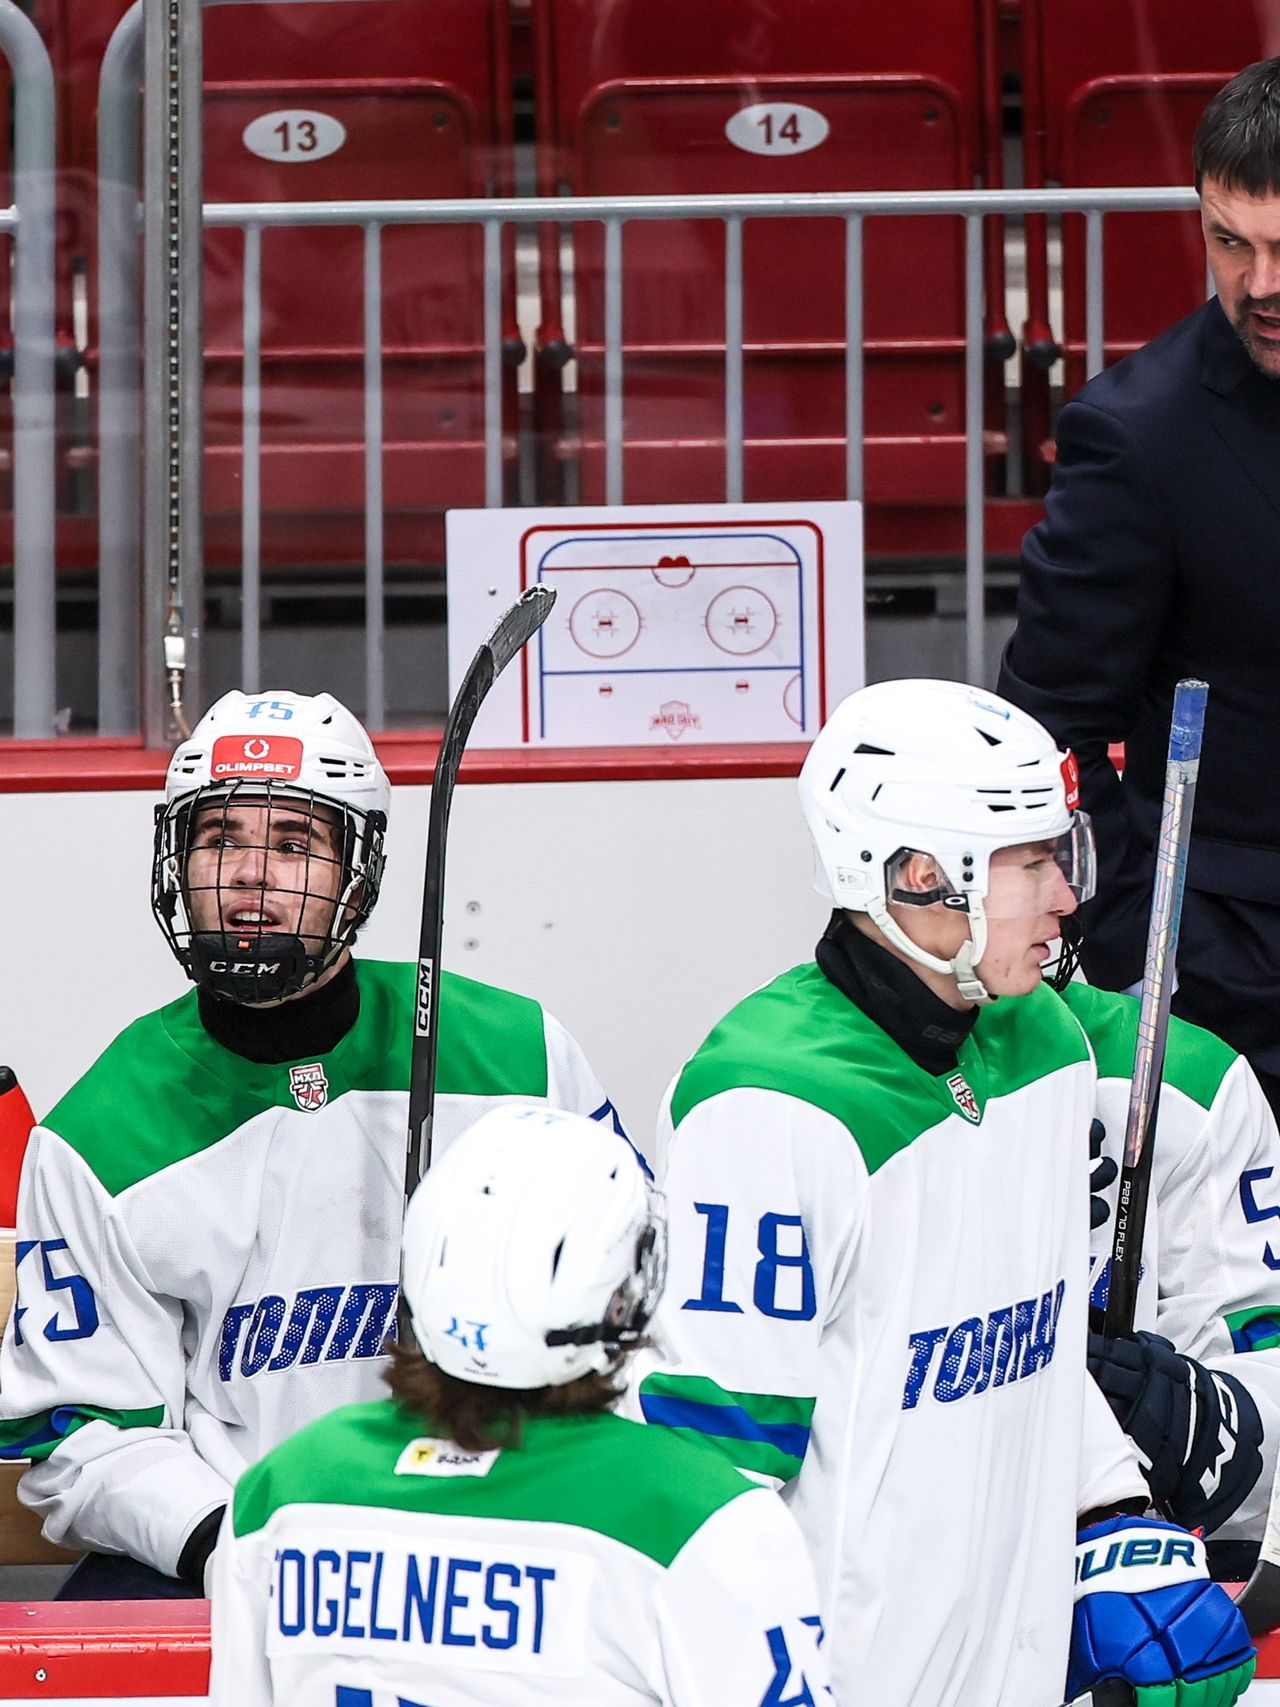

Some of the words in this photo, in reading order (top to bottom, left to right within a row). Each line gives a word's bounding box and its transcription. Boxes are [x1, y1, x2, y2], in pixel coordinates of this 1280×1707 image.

[274, 120, 318, 153] 13
[757, 112, 802, 146] 14
[245, 701, 295, 720] 75
[215, 762, 296, 774] OLIMPBET
[208, 960, 281, 978] CCM
[417, 963, 431, 1032] CCM
[680, 1201, 817, 1322] 18
[1114, 1231, 1126, 1263] FLEX
[1199, 1368, 1240, 1501] CM
[1075, 1538, 1197, 1586] UER
[269, 1548, 556, 1654] OGELNEST
